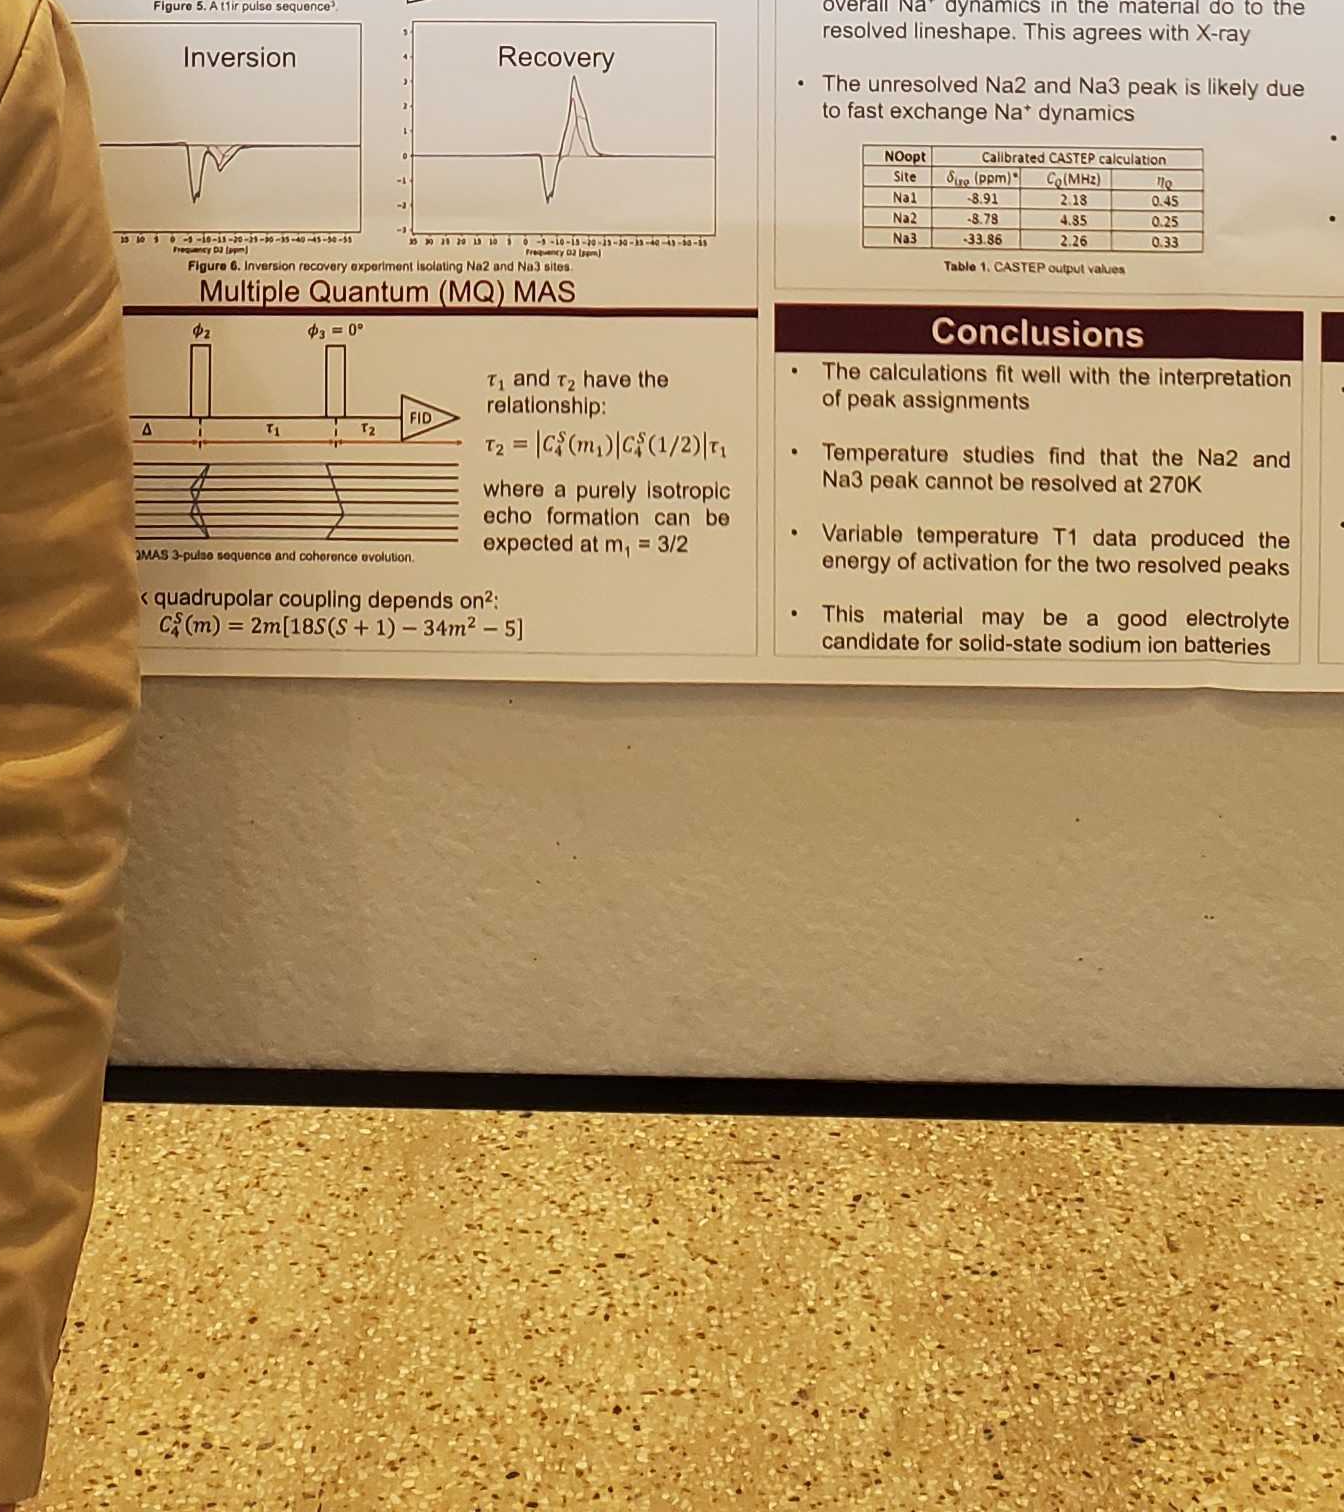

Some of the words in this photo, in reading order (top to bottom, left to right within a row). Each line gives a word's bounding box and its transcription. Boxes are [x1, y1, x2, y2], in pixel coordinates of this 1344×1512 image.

[184, 45, 296, 68] Inversion
[499, 45, 615, 74] Recovery
[200, 279, 300, 307] Multiple
[309, 279, 429, 304] Quantum
[439, 279, 505, 307] (MQ)
[514, 279, 576, 303] MAS
[931, 320, 1145, 352] Conclusions
[821, 361, 861, 381] The
[869, 362, 988, 383] calculations
[995, 364, 1014, 383] fit
[1021, 365, 1061, 384] well
[1068, 366, 1110, 385] with
[1118, 366, 1151, 386] the
[1159, 367, 1291, 390] interpretation
[483, 505, 532, 525] echo
[547, 506, 639, 526] formation
[654, 511, 690, 527] can
[705, 508, 730, 527] be
